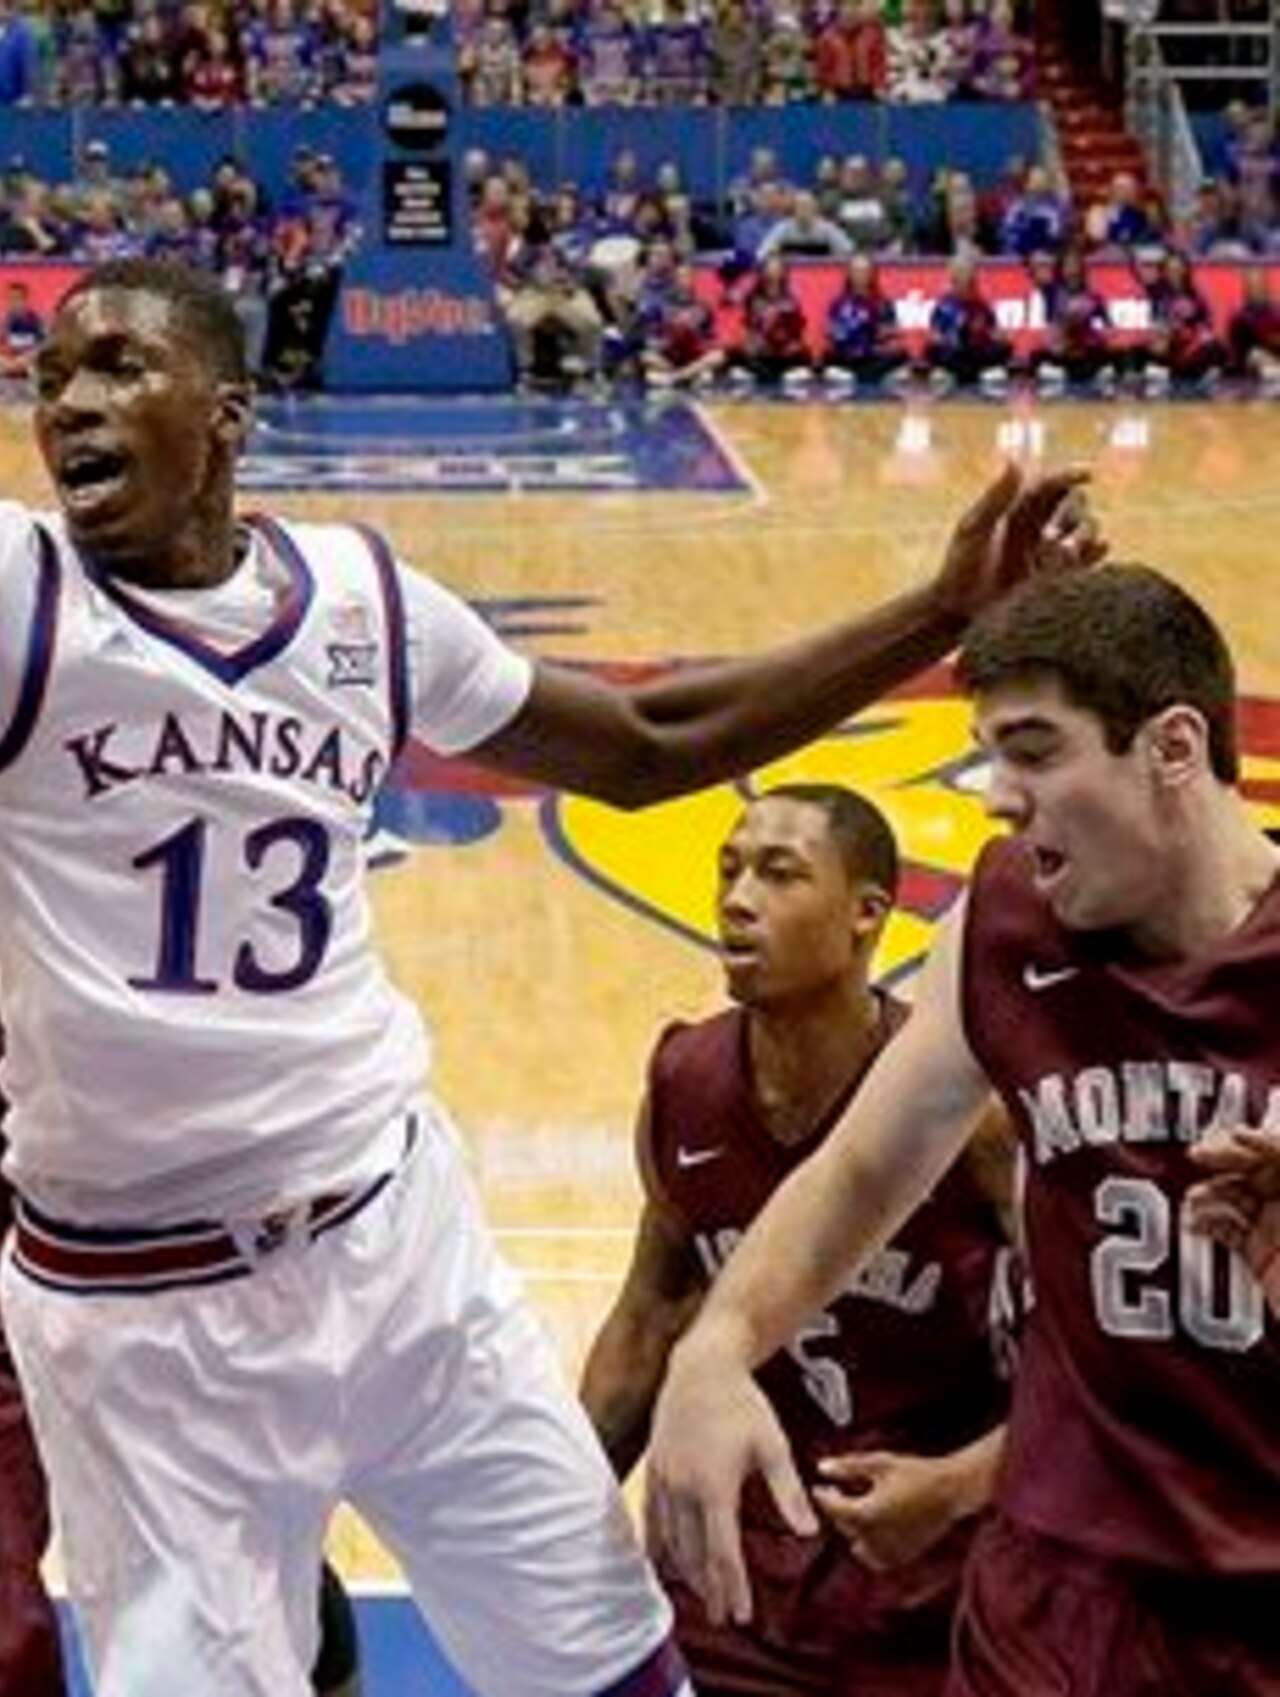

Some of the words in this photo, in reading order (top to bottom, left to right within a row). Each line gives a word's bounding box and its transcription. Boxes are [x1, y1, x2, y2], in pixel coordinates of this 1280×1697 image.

[64, 709, 385, 804] KANSAS
[127, 816, 334, 995] 13
[1090, 1175, 1265, 1352] 20
[786, 1311, 852, 1428] 5
